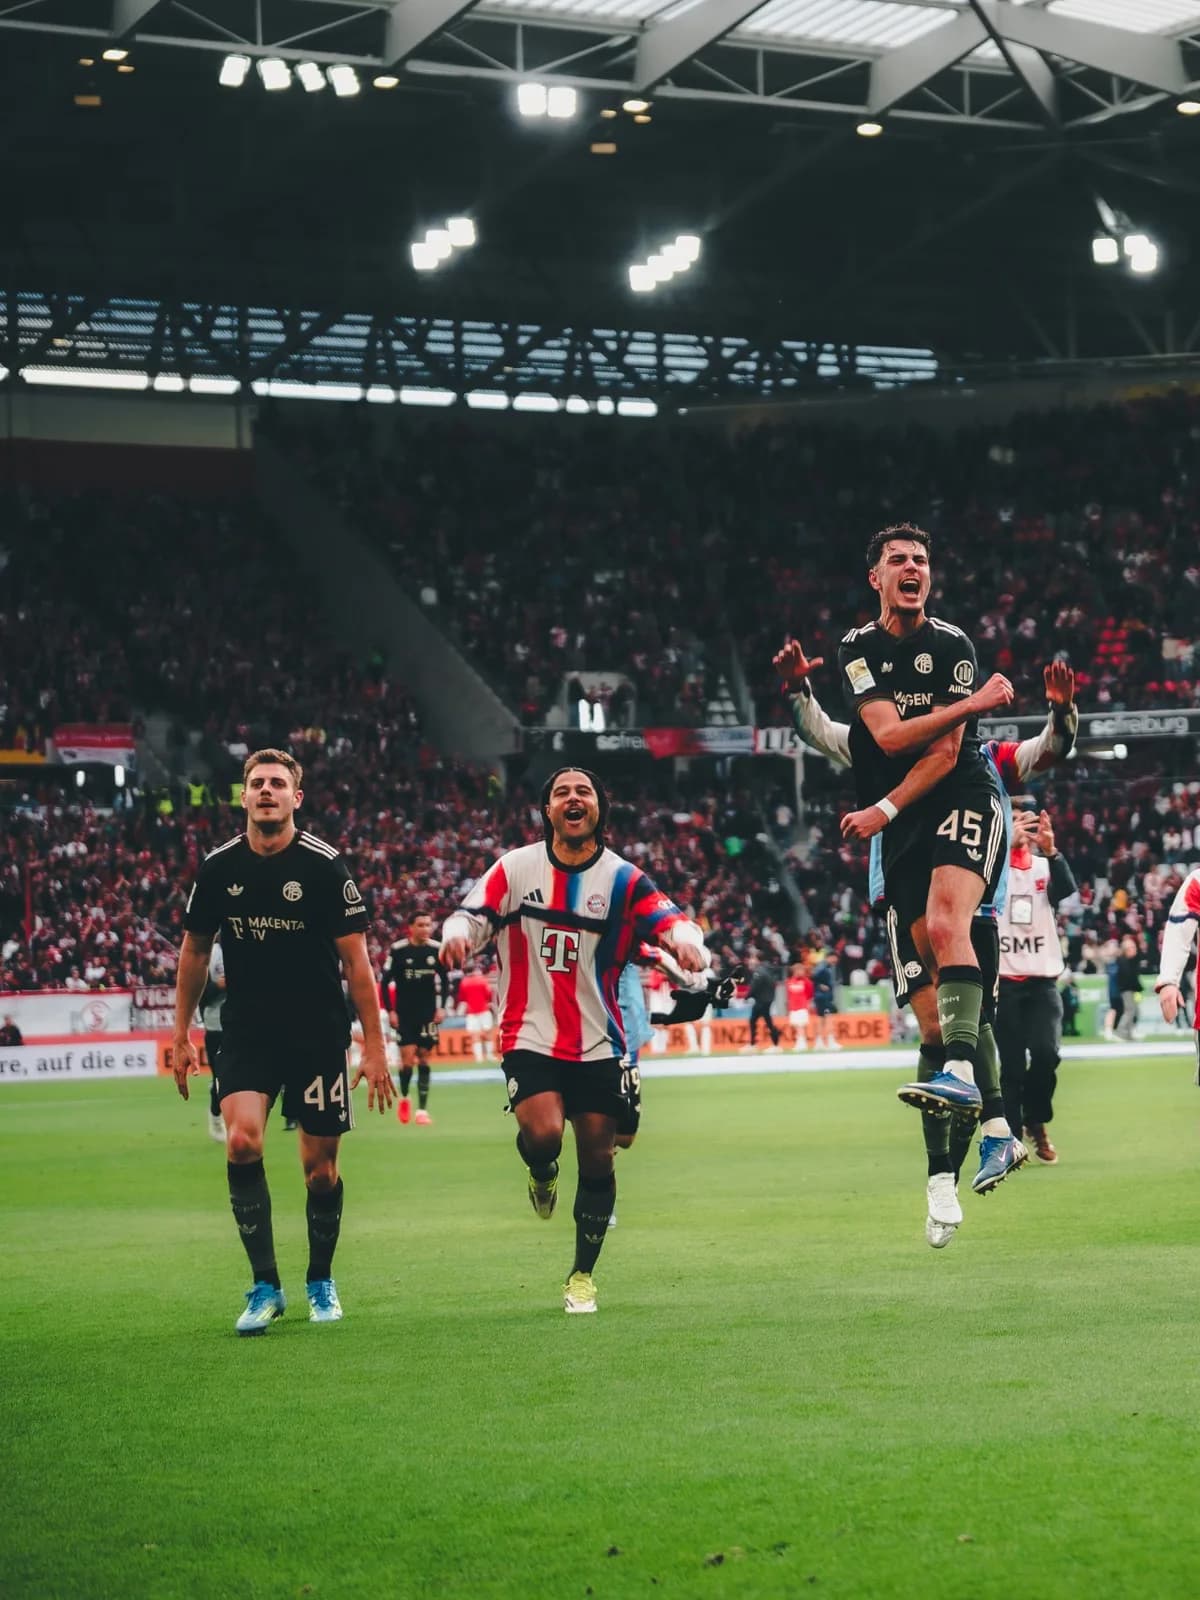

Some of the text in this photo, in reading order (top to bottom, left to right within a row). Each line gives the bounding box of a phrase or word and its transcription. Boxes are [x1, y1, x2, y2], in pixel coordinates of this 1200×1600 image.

[1089, 716, 1189, 736] scfreiburg
[936, 809, 983, 847] 45
[250, 929, 266, 941] TV
[1000, 936, 1045, 954] SMF
[37, 1051, 74, 1071] auf
[81, 1050, 115, 1069] die
[123, 1053, 147, 1067] es
[304, 1072, 345, 1111] 44
